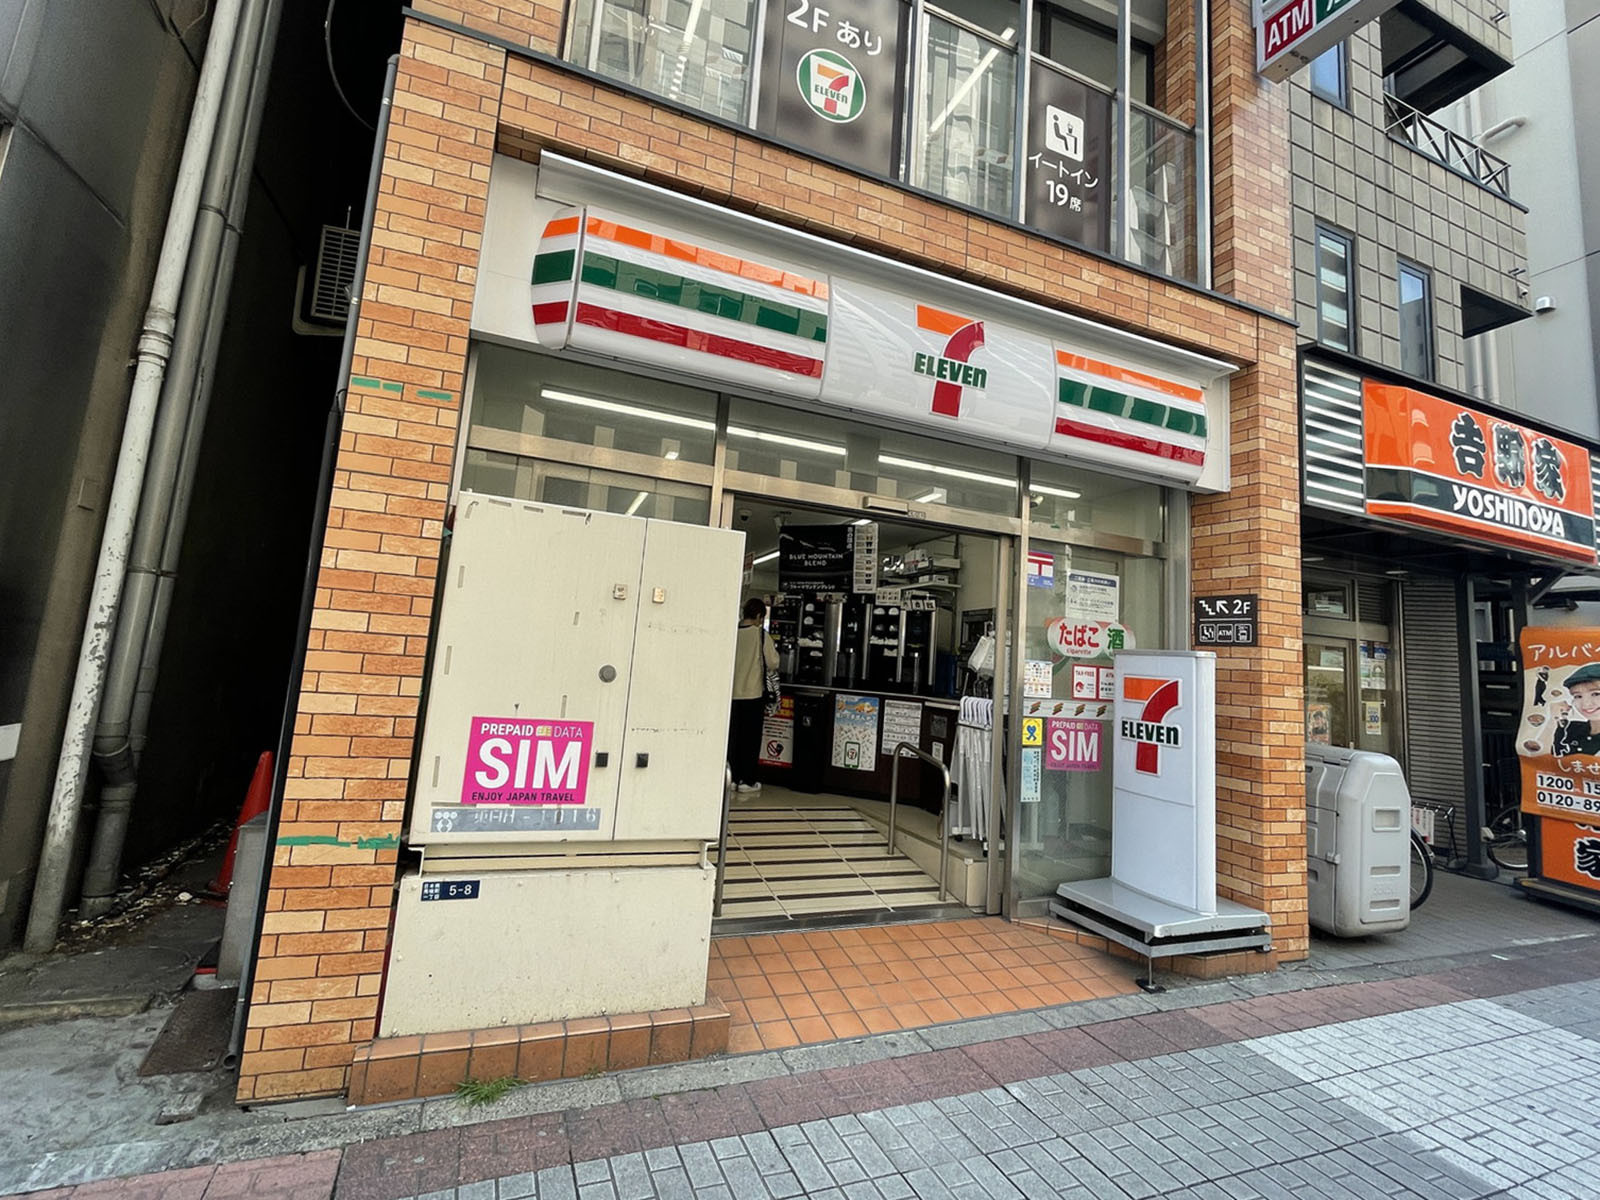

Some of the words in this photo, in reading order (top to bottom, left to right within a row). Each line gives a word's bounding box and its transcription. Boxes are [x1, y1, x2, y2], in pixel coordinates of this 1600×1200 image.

[787, 0, 830, 32] 2F
[837, 21, 882, 55] あり
[1268, 0, 1310, 52] ATM
[1028, 152, 1099, 188] イートイン
[1233, 600, 1251, 614] 2F
[1059, 623, 1100, 648] たばこ
[1107, 628, 1125, 650] 酒
[481, 723, 534, 737] PREPAID
[553, 726, 583, 739] DATA
[1051, 720, 1076, 729] PREPAID
[1051, 730, 1098, 762] SIM
[475, 738, 582, 790] SIM
[1538, 775, 1574, 790] 1200
[471, 792, 503, 801] ENJOY
[506, 792, 537, 801] JAPAN
[540, 792, 574, 801] TRAVEL
[449, 884, 472, 896] 5-8
